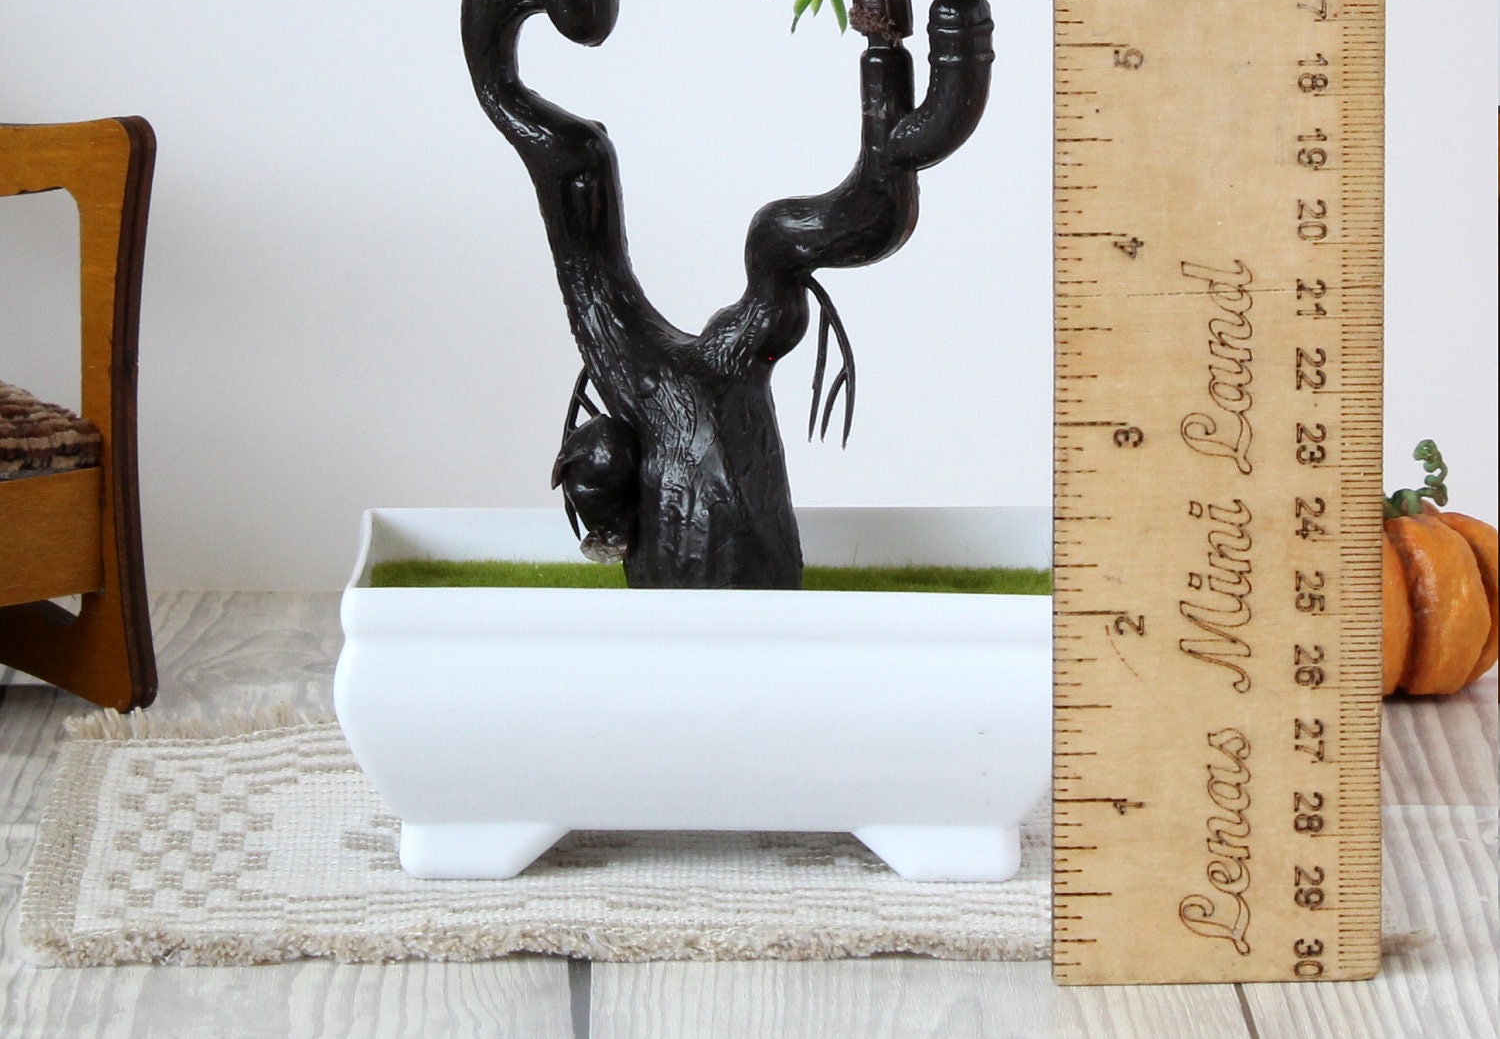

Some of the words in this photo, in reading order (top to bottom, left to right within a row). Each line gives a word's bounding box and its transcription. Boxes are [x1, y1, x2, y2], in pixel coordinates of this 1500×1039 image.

[1113, 48, 1145, 70] 5
[1296, 52, 1327, 94] 18
[1296, 127, 1327, 169] 19
[1295, 198, 1327, 242] 20
[1113, 237, 1145, 259] 4
[1295, 278, 1327, 316] 21
[1180, 259, 1254, 476] Land
[1295, 347, 1327, 391] 22
[1113, 426, 1145, 448] 3
[1295, 422, 1326, 464] 23
[1295, 496, 1326, 540] 24
[1179, 498, 1253, 693] Mini
[1294, 570, 1326, 615] 25
[1113, 614, 1145, 636] 2
[1294, 644, 1326, 688] 26
[1294, 718, 1326, 762] 27
[1113, 800, 1145, 815] 1
[1294, 791, 1325, 834] 28
[1178, 727, 1252, 956] Lenas
[1294, 865, 1325, 910] 29
[1294, 938, 1325, 980] 30
